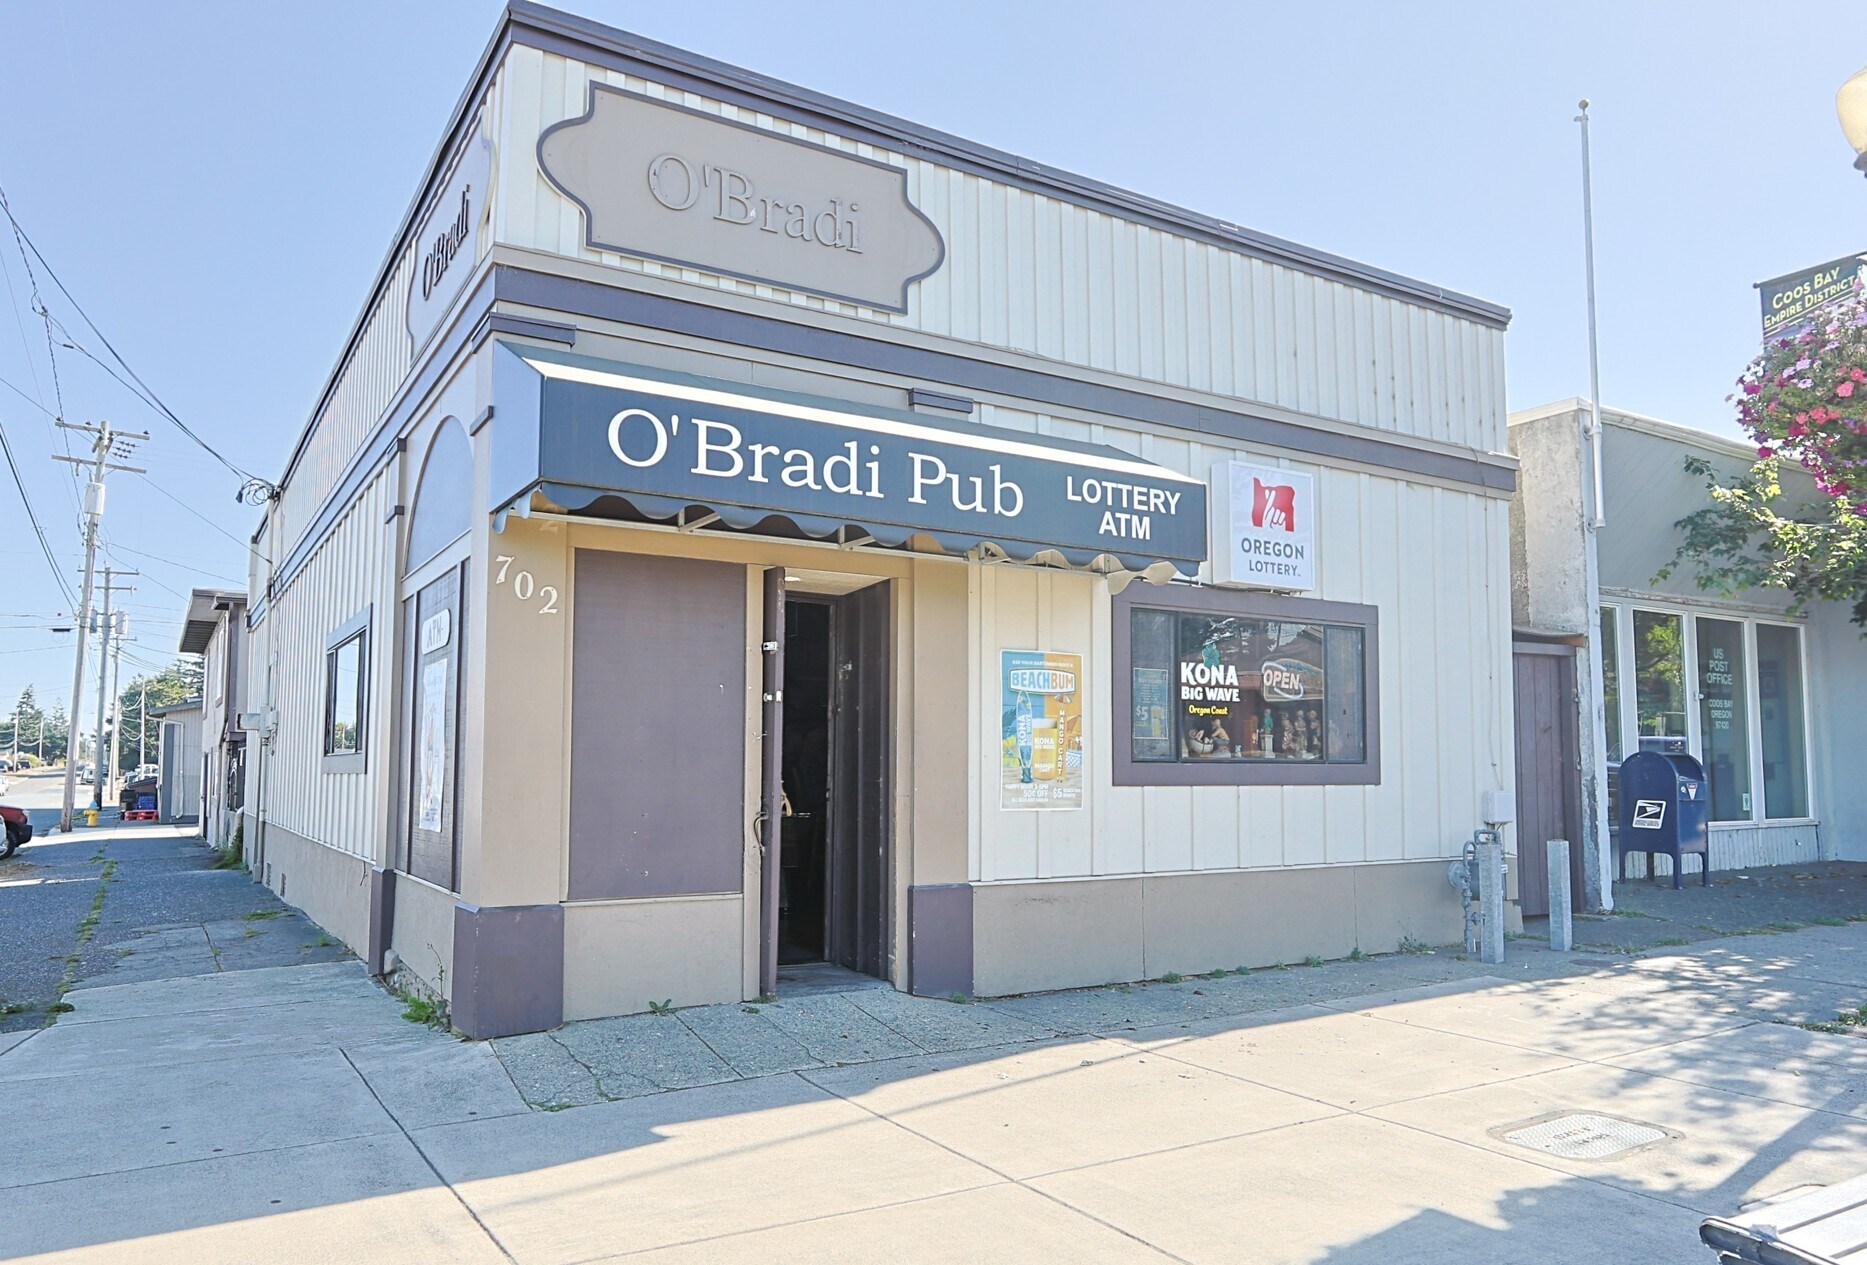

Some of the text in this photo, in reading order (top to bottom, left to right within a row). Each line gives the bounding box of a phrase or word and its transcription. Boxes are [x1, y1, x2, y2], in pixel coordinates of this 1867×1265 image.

[648, 153, 863, 254] O'Bradi
[1772, 267, 1840, 309] COOS BAY
[1764, 275, 1856, 328] EMPIRE DISTRICT
[606, 408, 1024, 517] O'Bradi Pub
[1066, 476, 1181, 515] LOTTERY
[1098, 511, 1151, 541] ATM
[1241, 538, 1304, 560] OREGON
[1713, 648, 1724, 659] US
[1180, 662, 1239, 686] KONA
[1709, 660, 1728, 672] POST
[1264, 669, 1300, 690] OPEN
[1707, 672, 1733, 685] OFFICE
[1205, 687, 1240, 702] WAVE
[1708, 699, 1733, 708] COOS BAY
[1189, 705, 1228, 716] Oregon Coast
[1711, 709, 1732, 719] OREGON
[1018, 714, 1027, 746] KONA
[1034, 737, 1054, 745] KONA
[1053, 787, 1062, 799] $5
